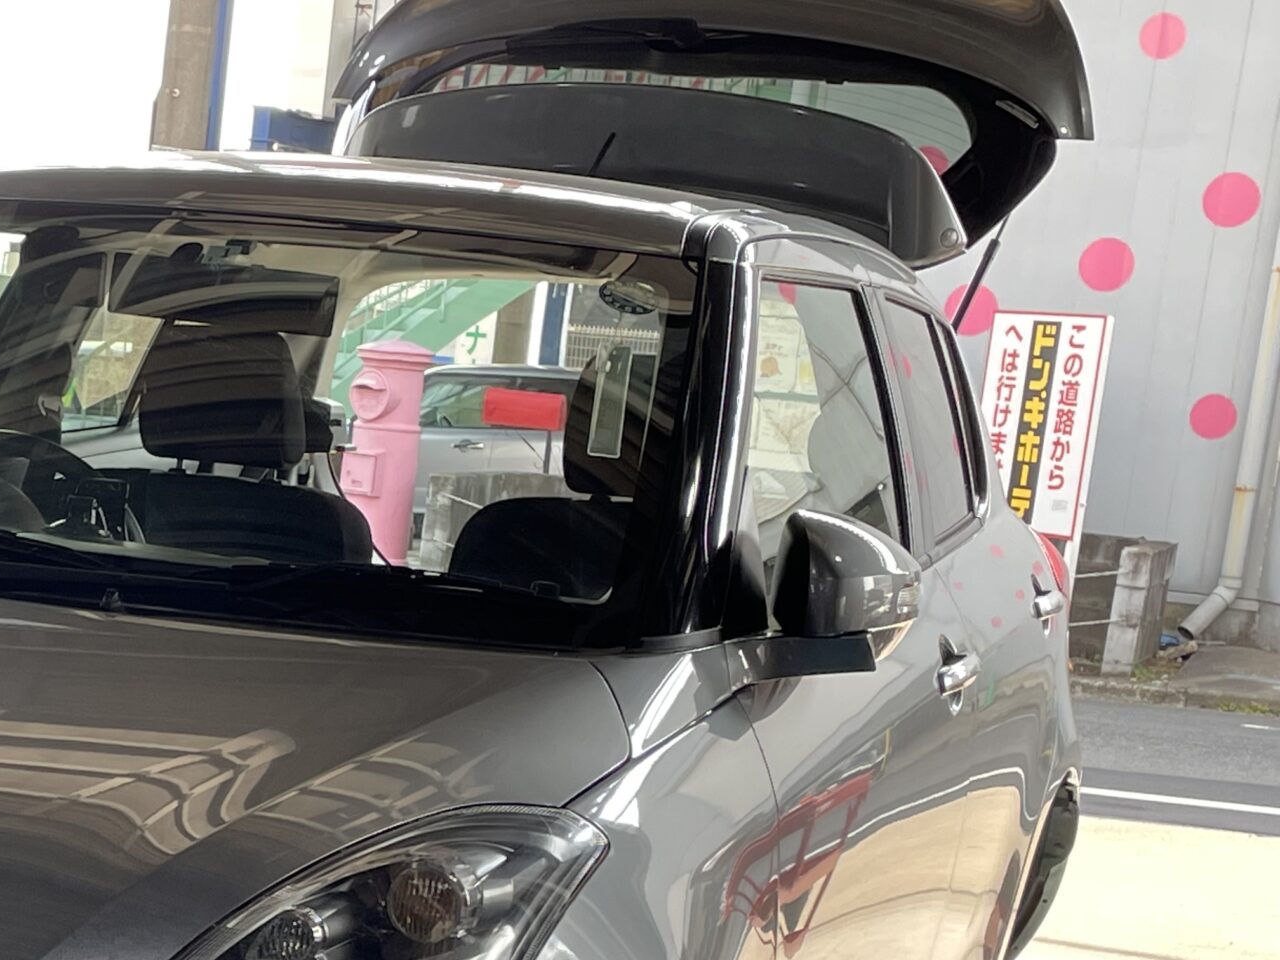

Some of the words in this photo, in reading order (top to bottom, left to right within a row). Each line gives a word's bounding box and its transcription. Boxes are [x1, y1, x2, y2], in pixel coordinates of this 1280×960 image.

[990, 325, 1023, 469] へは行けま
[1047, 325, 1087, 490] この道路から
